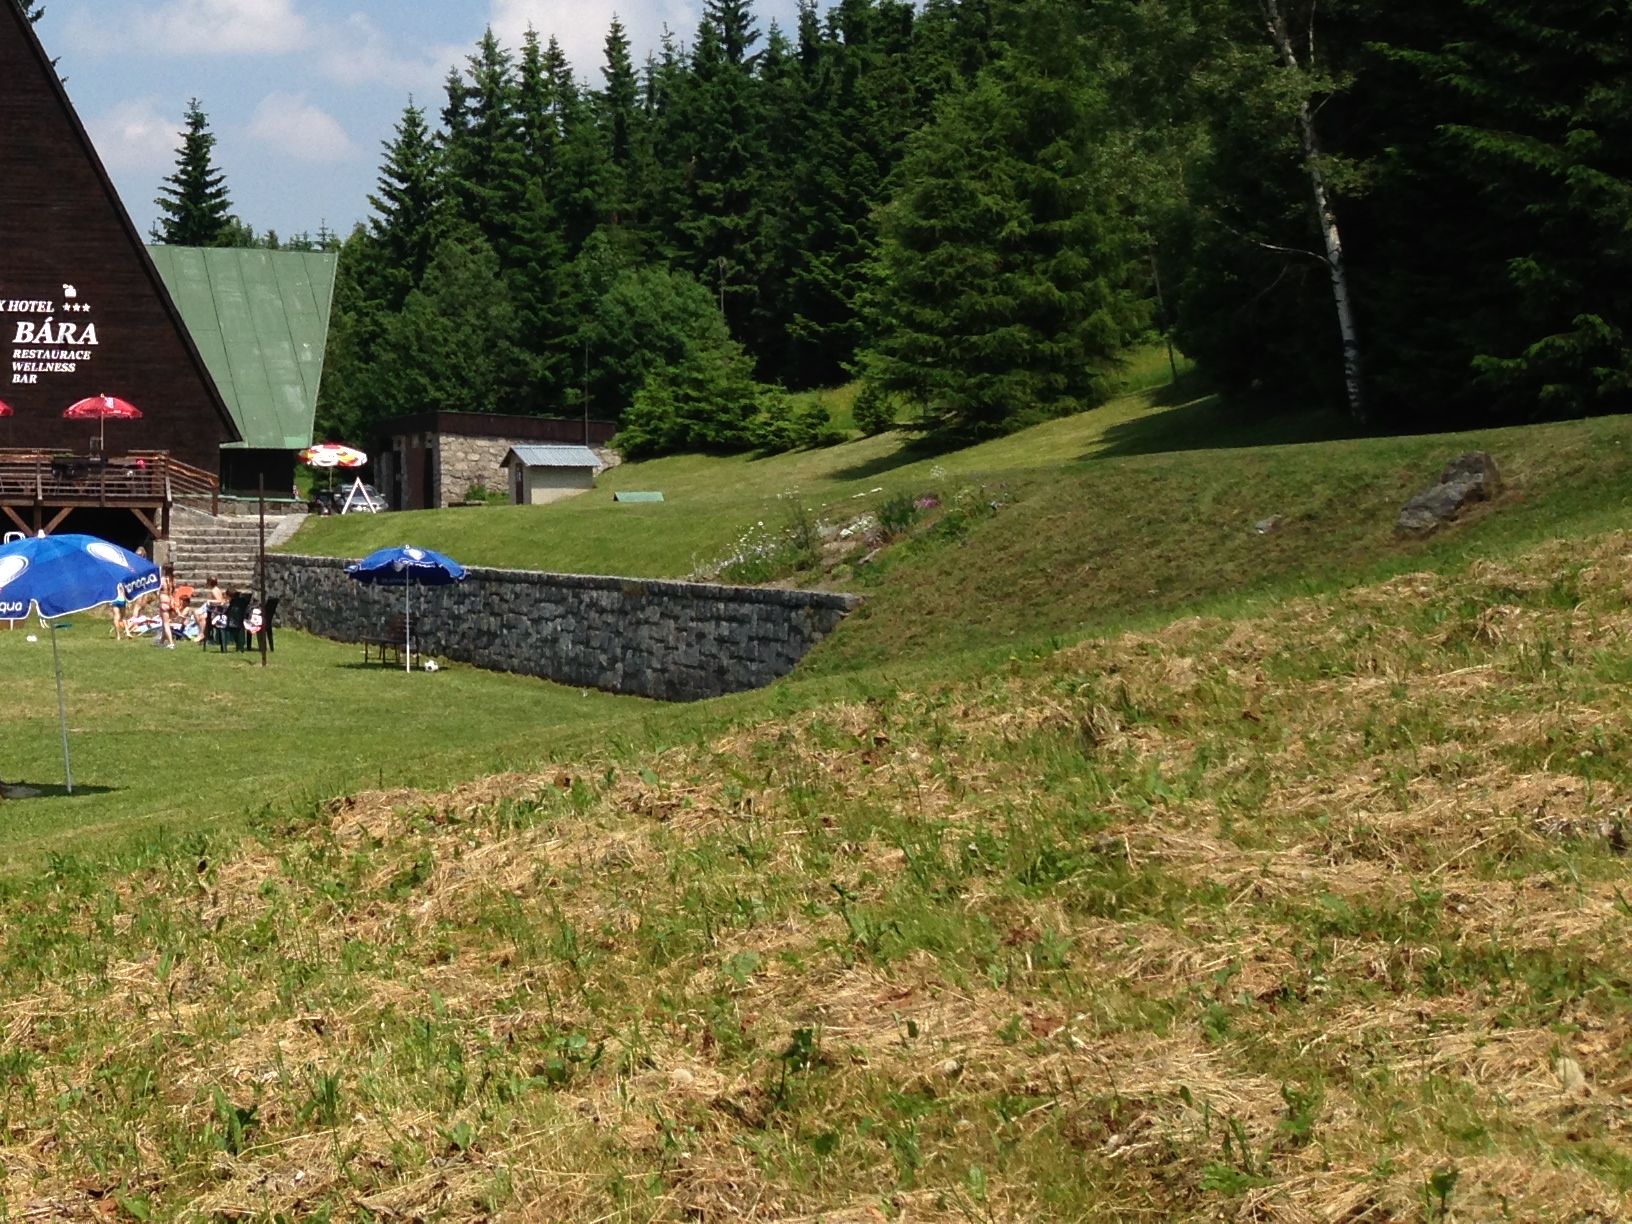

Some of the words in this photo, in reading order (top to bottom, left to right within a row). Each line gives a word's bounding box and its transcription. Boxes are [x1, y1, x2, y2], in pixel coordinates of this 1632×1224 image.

[7, 300, 55, 312] HOTEL
[12, 316, 99, 344] BÁRA
[12, 349, 91, 360] RESTAURACE
[12, 361, 76, 372] WELLNESS
[12, 373, 37, 384] BAR
